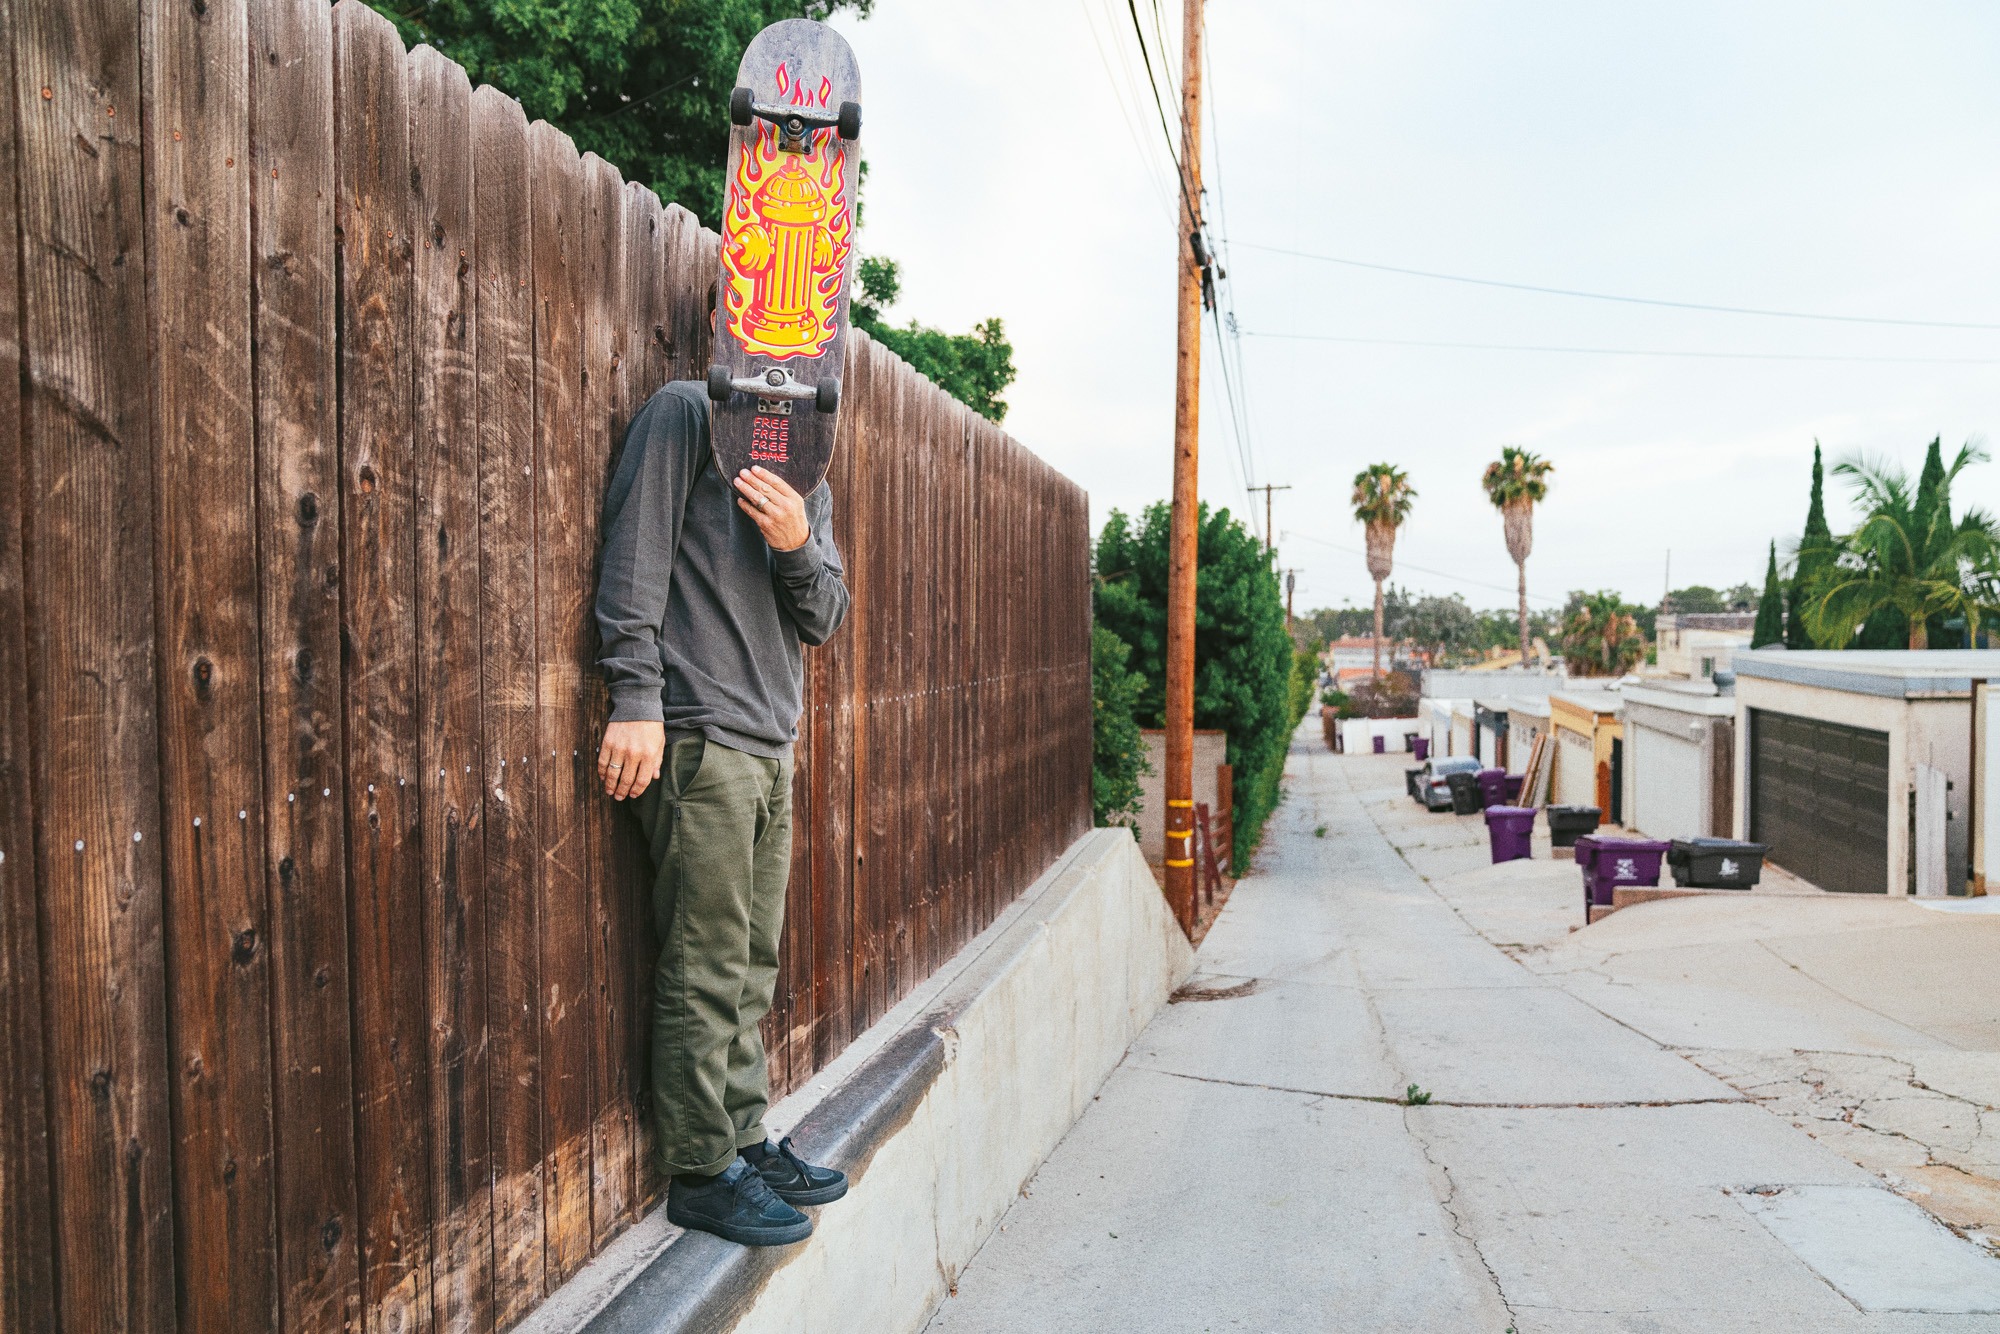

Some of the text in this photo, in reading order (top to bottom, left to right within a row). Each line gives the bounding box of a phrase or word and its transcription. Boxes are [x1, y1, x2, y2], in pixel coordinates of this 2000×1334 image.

[754, 416, 789, 430] FREE
[753, 428, 788, 441] FREE
[752, 440, 787, 452] FREE
